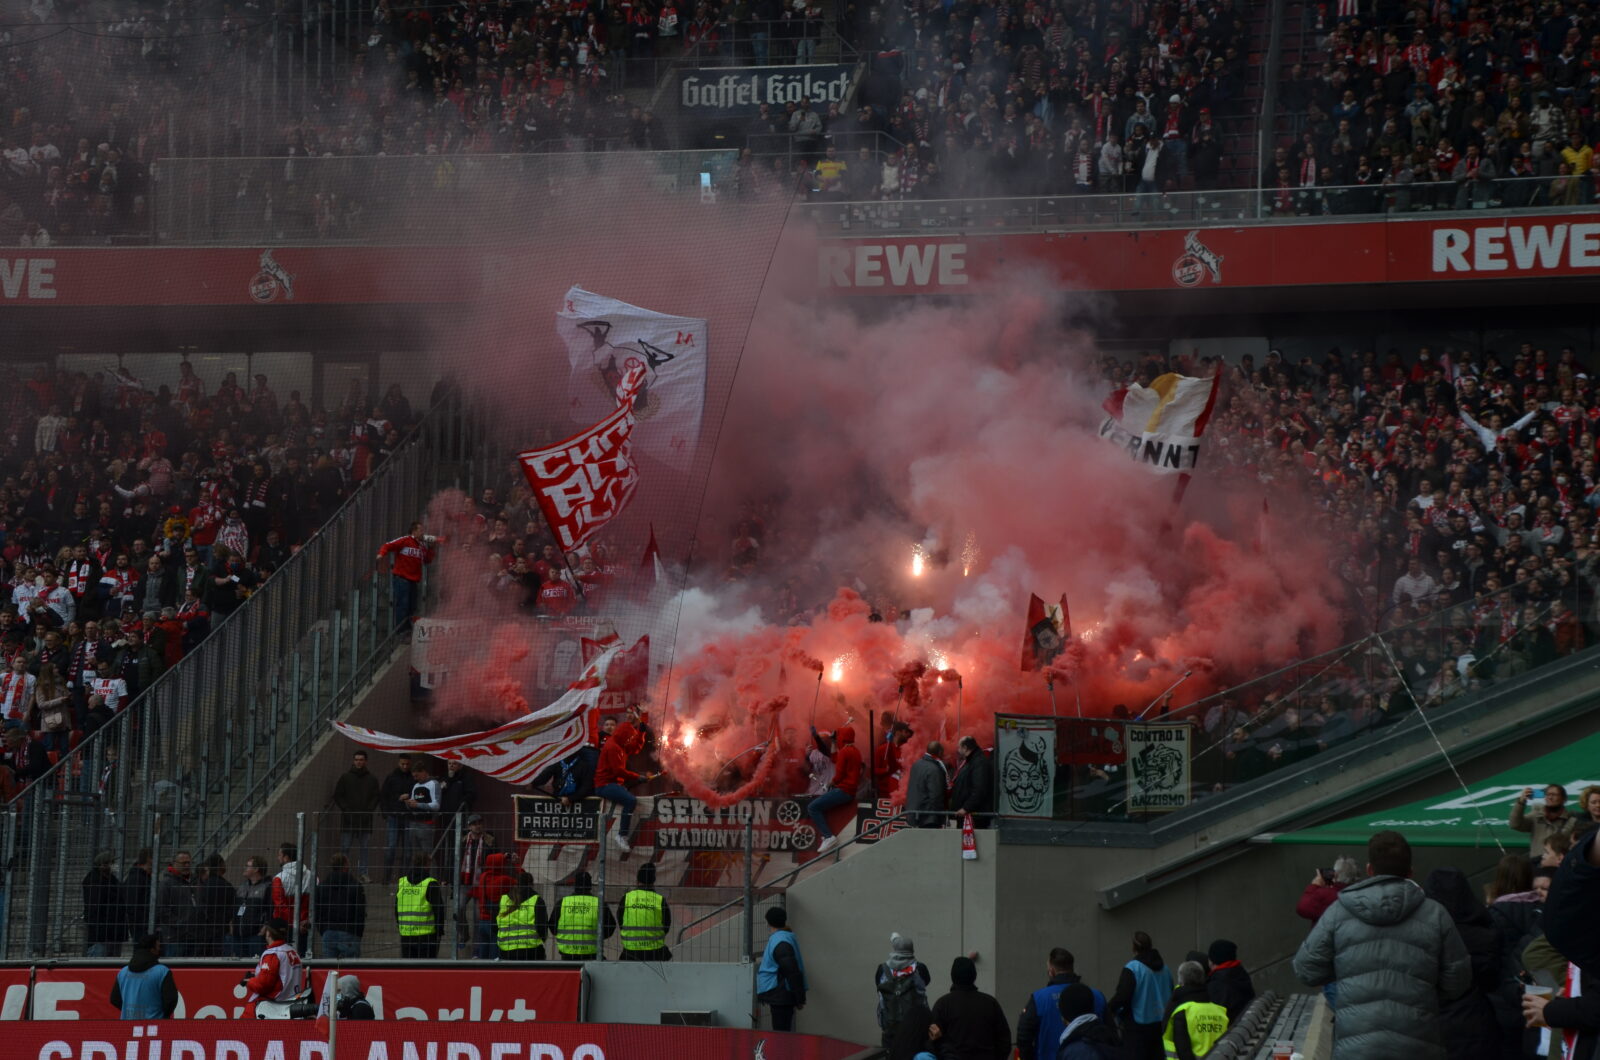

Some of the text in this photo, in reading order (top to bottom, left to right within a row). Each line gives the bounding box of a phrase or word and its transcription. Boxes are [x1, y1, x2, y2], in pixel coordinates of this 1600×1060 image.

[682, 74, 761, 109] Gaffel
[1432, 223, 1600, 272] REWE
[819, 244, 969, 287] REWE
[1131, 730, 1185, 742] CONTRO IL
[523, 816, 593, 829] PARADISO
[657, 799, 773, 826] SEKTION
[1196, 1023, 1223, 1033] ORDNER
